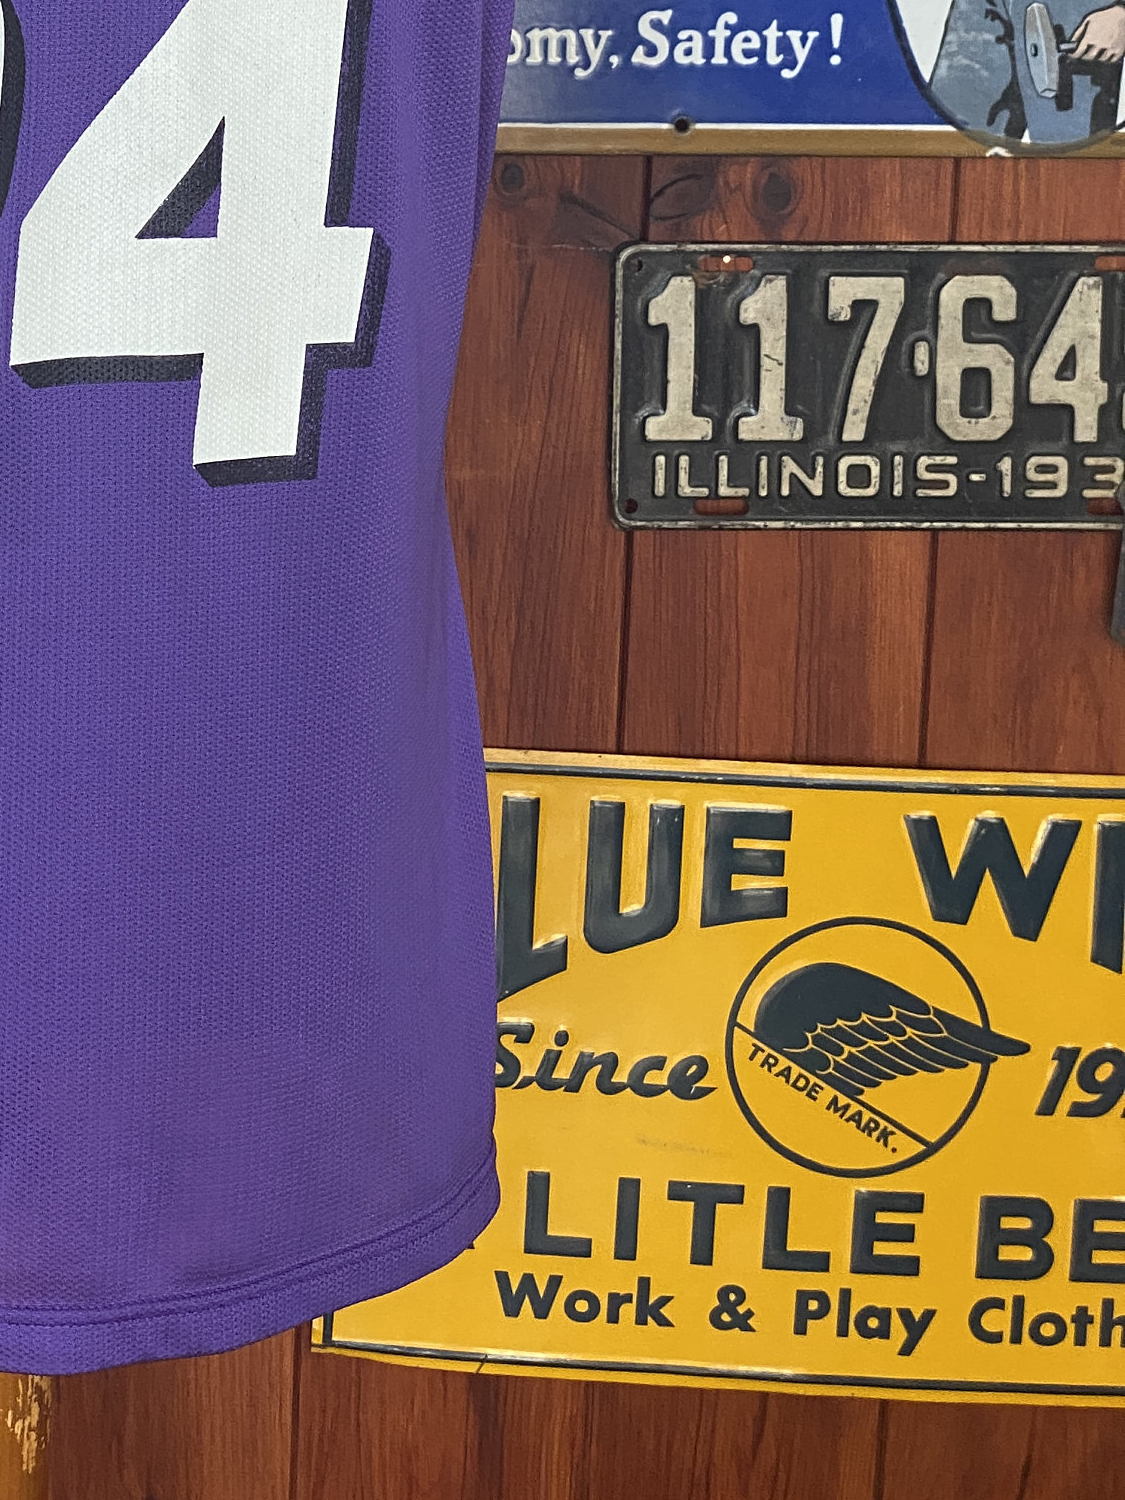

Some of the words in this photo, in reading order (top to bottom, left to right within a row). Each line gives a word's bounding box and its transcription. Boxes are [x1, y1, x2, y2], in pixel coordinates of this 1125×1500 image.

[495, 1020, 717, 1101] Since
[1035, 1045, 1125, 1118] 19
[748, 1042, 824, 1102] TRADE
[524, 1170, 924, 1277] LITLE
[975, 1195, 1125, 1284] BE
[494, 1270, 675, 1327] Work
[709, 1284, 757, 1332] &
[793, 1288, 937, 1357] Play
[968, 1295, 1125, 1348] Cloth
